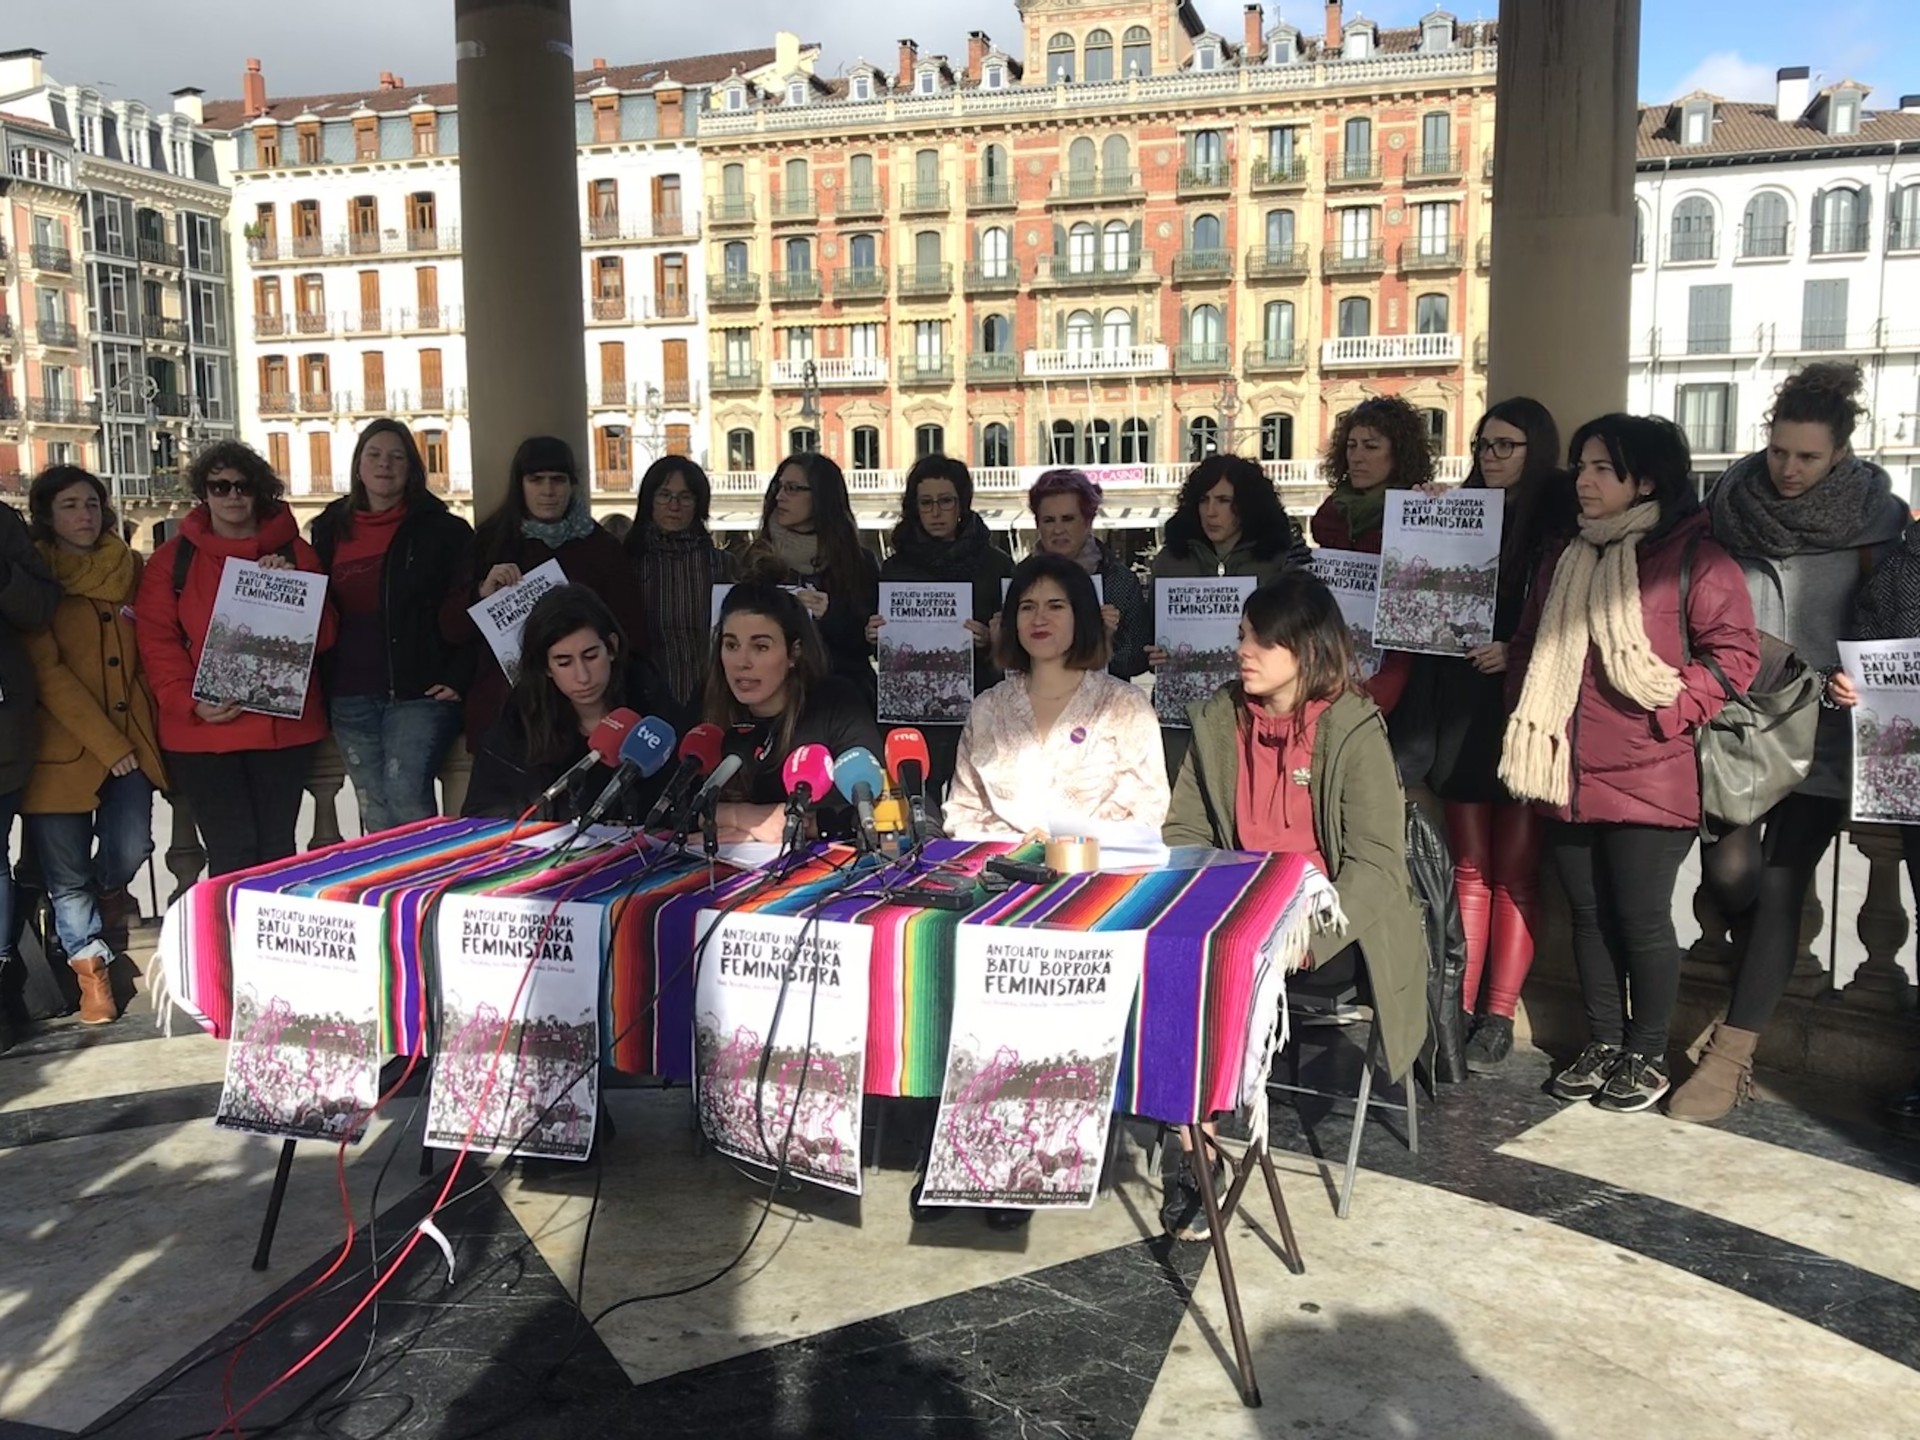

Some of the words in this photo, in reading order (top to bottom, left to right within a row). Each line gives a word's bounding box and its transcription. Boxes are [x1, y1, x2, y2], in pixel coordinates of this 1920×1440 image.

[1404, 506, 1431, 516] BATU
[1437, 506, 1485, 517] BORROKA
[1402, 516, 1483, 529] FEMINISTARA
[1335, 569, 1378, 580] BORROKA
[238, 577, 262, 588] BATU
[265, 582, 308, 597] BORROKA
[235, 586, 305, 607] FEMINISTARA
[891, 598, 912, 607] BATU
[916, 598, 957, 607] BORROKA
[1168, 594, 1191, 604] BATU
[1196, 594, 1240, 603] BORROKA
[490, 604, 514, 622] BATU
[890, 607, 957, 617] FEMINISTARA
[1168, 603, 1240, 615] FEMINISTARA
[1860, 652, 1909, 661] ANTOLATU
[1862, 661, 1896, 673] BATU
[1864, 672, 1920, 686] FEMINI
[636, 725, 661, 749] tve
[257, 906, 304, 923] ANTOLATU
[308, 914, 356, 930] INDARRAK
[463, 908, 517, 923] ANTOLATU
[257, 918, 291, 935] BATU
[298, 924, 356, 945] BORROKA
[463, 921, 500, 937] BATU
[508, 925, 574, 943] BORROKA
[722, 928, 780, 944] ANTOLATU
[257, 933, 356, 962] FEMINISTARA
[462, 937, 573, 961] FEMINISTARA
[722, 941, 762, 958] BATU
[986, 944, 1049, 959] ANTOLATU
[1054, 948, 1114, 961] INDARRAK
[721, 957, 840, 986] FEMINISTARA
[986, 958, 1030, 974] BATU
[1040, 961, 1111, 977] BORROKA
[985, 975, 1106, 997] FEMINISTARA
